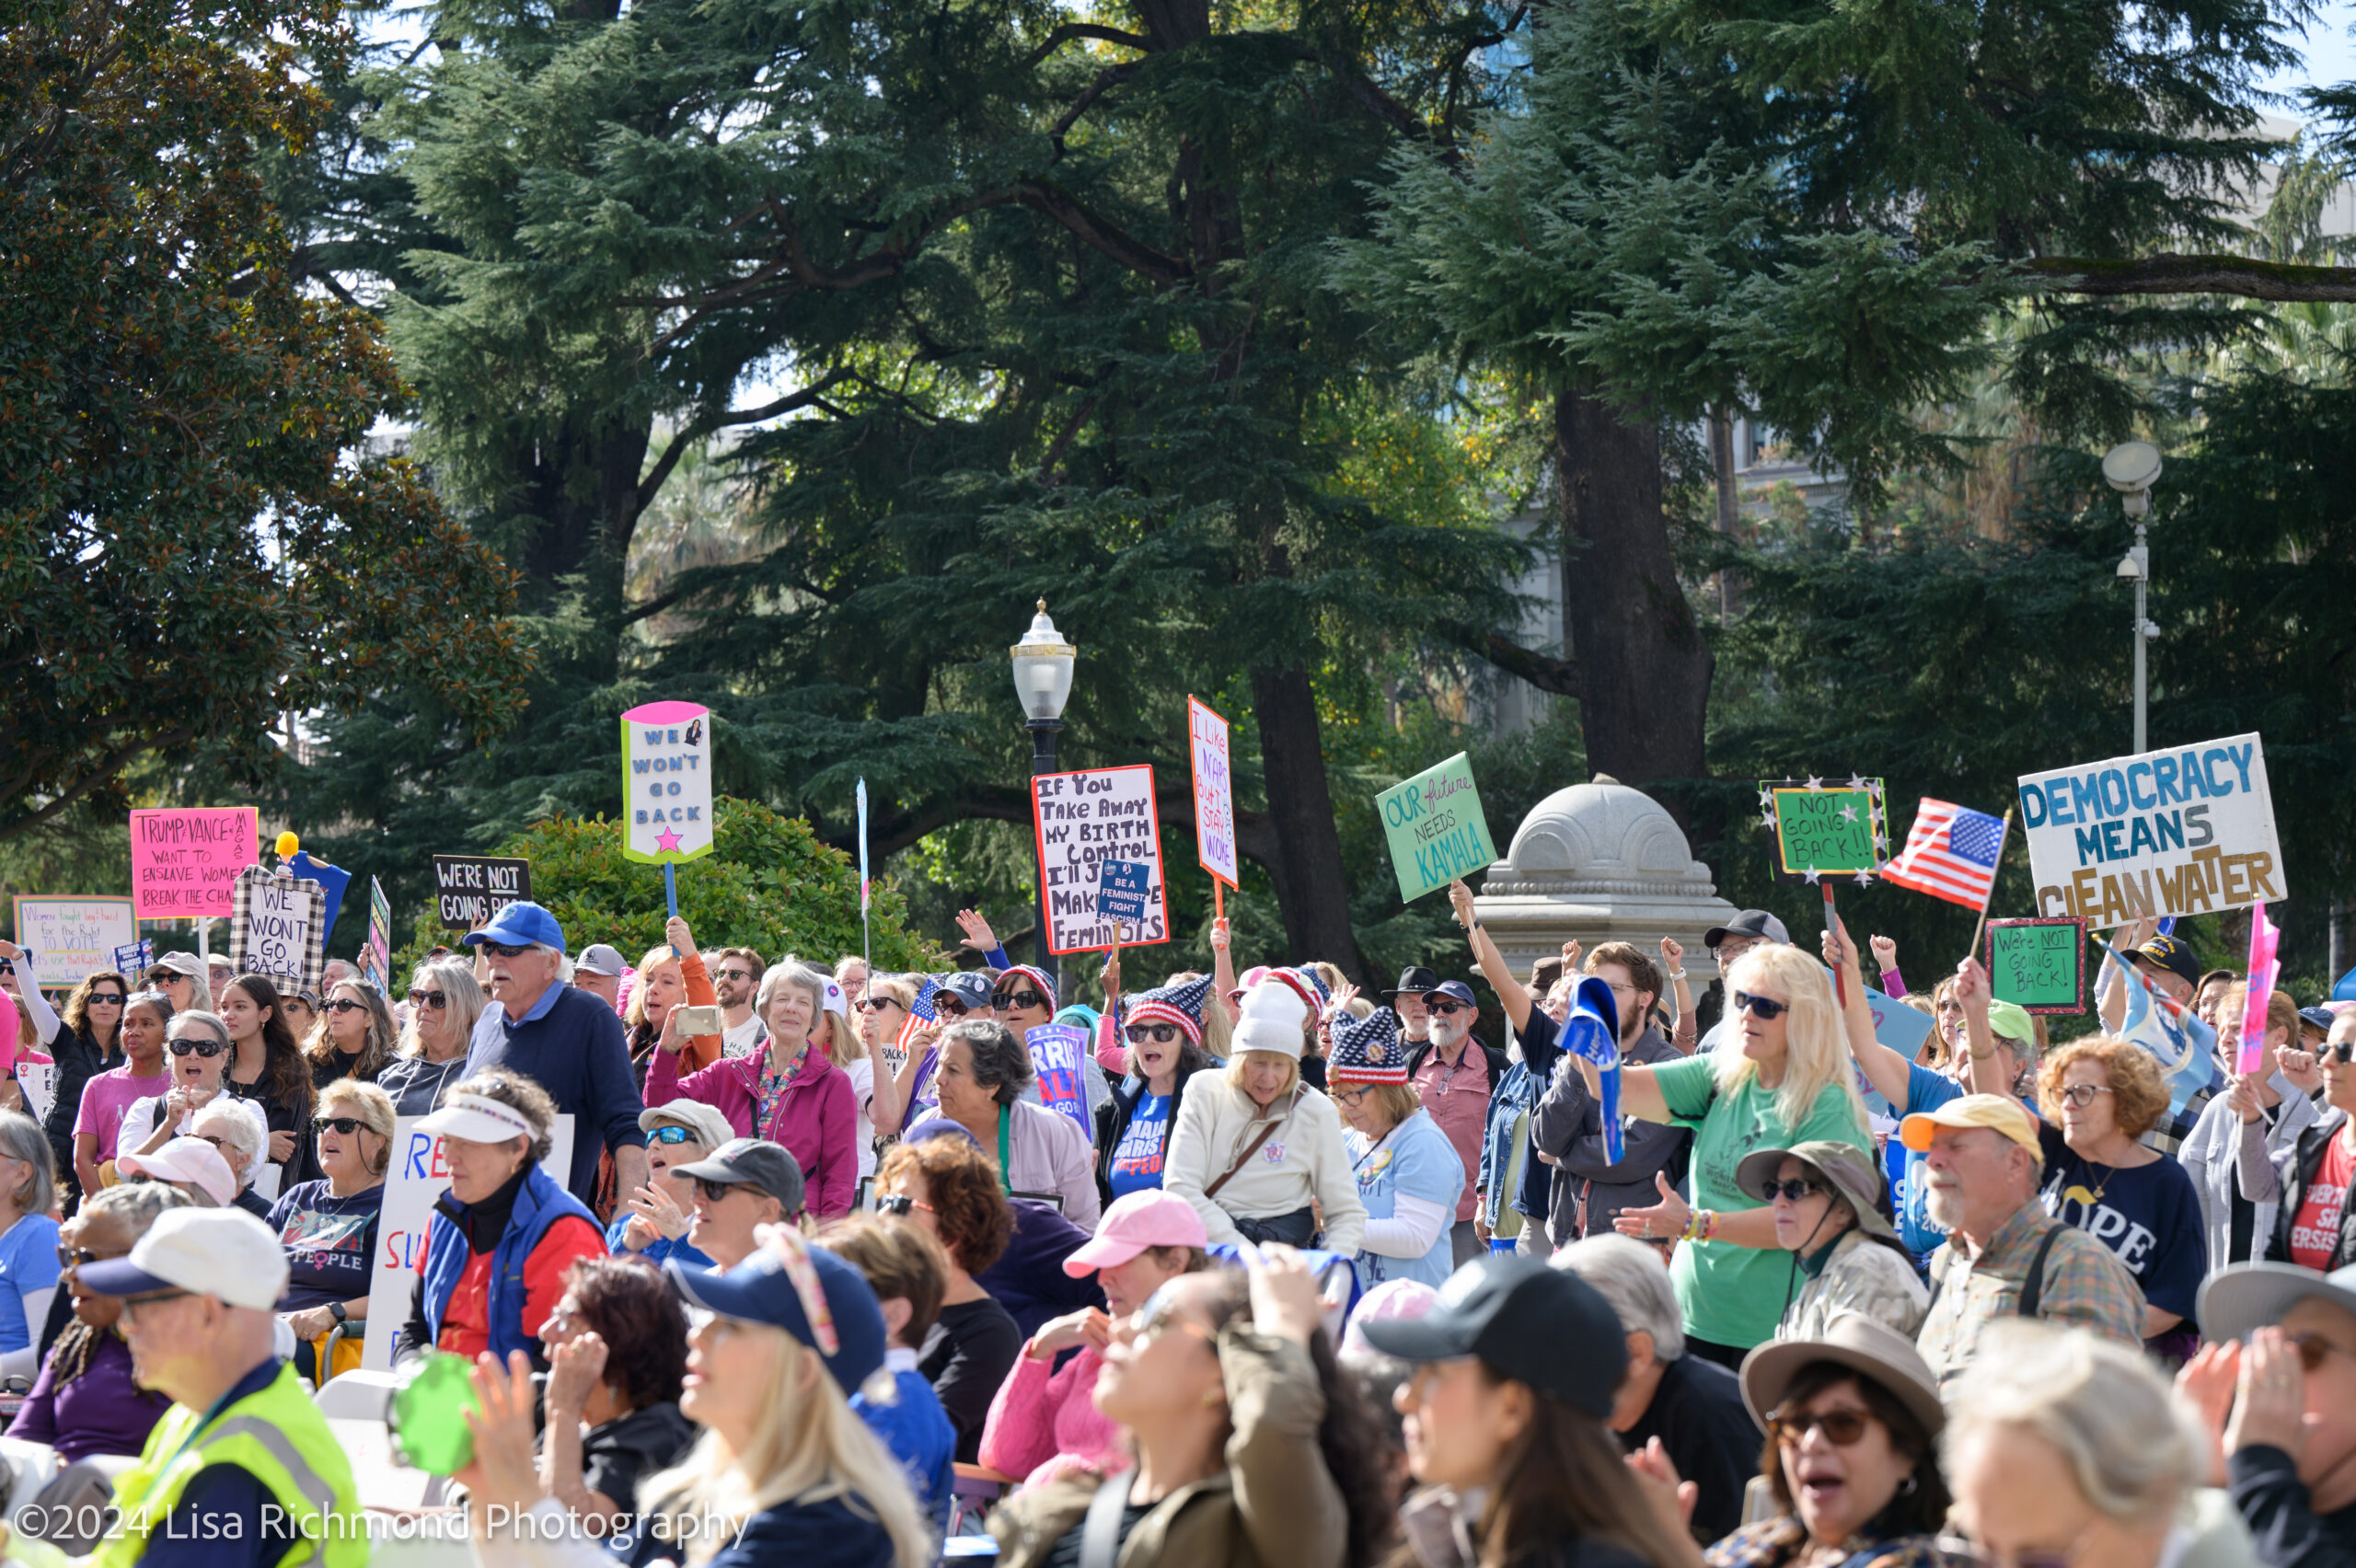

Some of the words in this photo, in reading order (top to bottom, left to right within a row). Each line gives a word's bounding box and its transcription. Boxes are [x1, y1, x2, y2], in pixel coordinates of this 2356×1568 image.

[644, 729, 679, 746] WE
[1205, 719, 1225, 755] Like
[632, 753, 699, 774] WON'T
[1203, 747, 1227, 793] NAPS
[649, 781, 681, 797] GO
[1071, 773, 1113, 796] You
[1195, 774, 1215, 806] But
[2019, 743, 2253, 829] DEMOCRACY
[1386, 785, 1426, 827] OUR
[1424, 774, 1472, 814] future
[1799, 793, 1839, 814] NOT
[635, 806, 700, 824] BACK
[1203, 805, 1224, 836] STAY
[1415, 809, 1456, 844] NEEDS
[1784, 813, 1844, 836] GOING
[1045, 824, 1069, 844] MY
[1080, 819, 1150, 841] BIRTH
[2074, 803, 2214, 866] MEANS
[151, 849, 188, 865] WANT
[192, 849, 213, 863] TO
[1204, 830, 1230, 868] WOKE
[1415, 822, 1487, 888] KAMALA
[143, 866, 194, 882] ENSLAVE
[436, 862, 484, 889] WE'RE
[487, 865, 519, 890] NOT
[1114, 877, 1127, 888] BE
[1128, 880, 1136, 889] A
[2155, 845, 2279, 914] WATER
[143, 888, 180, 907] BREAK
[181, 888, 203, 905] THE
[206, 888, 234, 904] CHA
[261, 884, 294, 911] WE
[1102, 887, 1145, 903] FEMINIST.
[441, 894, 489, 921] GOING
[1108, 901, 1137, 914] FIGHT
[41, 923, 54, 936] for
[62, 923, 75, 936] the
[2041, 929, 2070, 947] NOT
[42, 936, 57, 951] TO
[64, 935, 100, 951] VOTE
[118, 943, 140, 955] HARRIS
[260, 939, 286, 960] GO
[120, 957, 142, 969] HARRIS
[246, 954, 304, 977] BACK!
[2008, 951, 2052, 970] GOING
[2014, 957, 2068, 993] BACK!
[1029, 1038, 1076, 1072] RRIS
[1038, 1071, 1077, 1102] ALZ
[2316, 1207, 2340, 1230] SH
